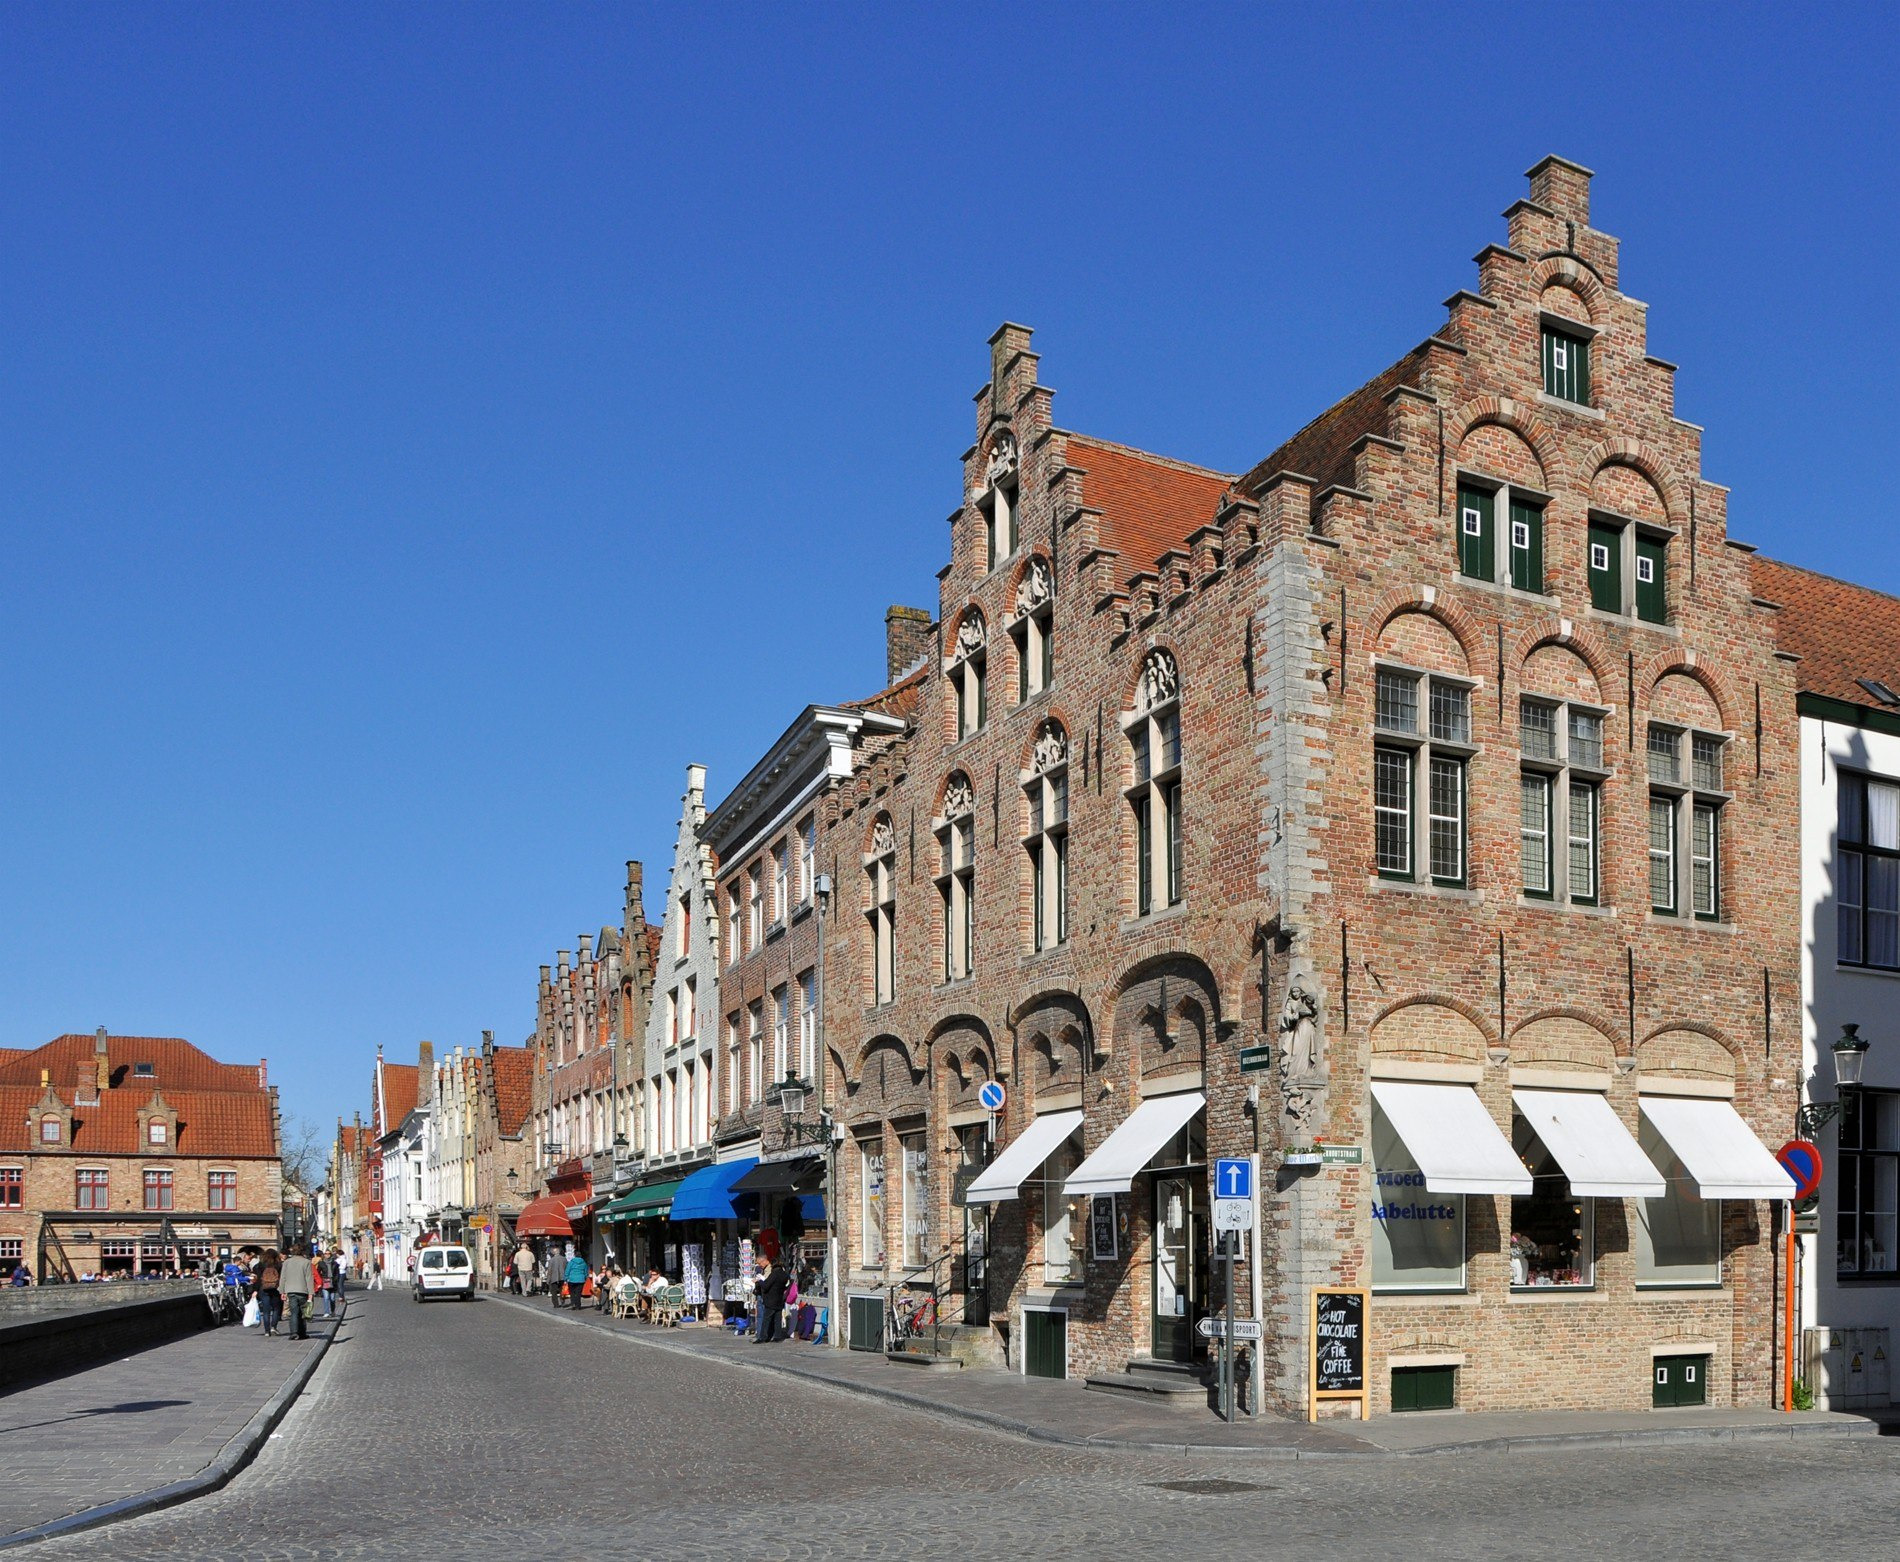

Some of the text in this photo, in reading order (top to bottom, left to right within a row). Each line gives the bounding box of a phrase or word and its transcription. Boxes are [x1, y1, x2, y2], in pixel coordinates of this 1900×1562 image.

[1323, 1150, 1358, 1158] KHOUTSTRAAT
[1330, 1310, 1346, 1323] HOT
[1317, 1323, 1358, 1338] CHOCOLATE
[1330, 1345, 1347, 1358] FINE
[1323, 1359, 1352, 1374] COFFEE
